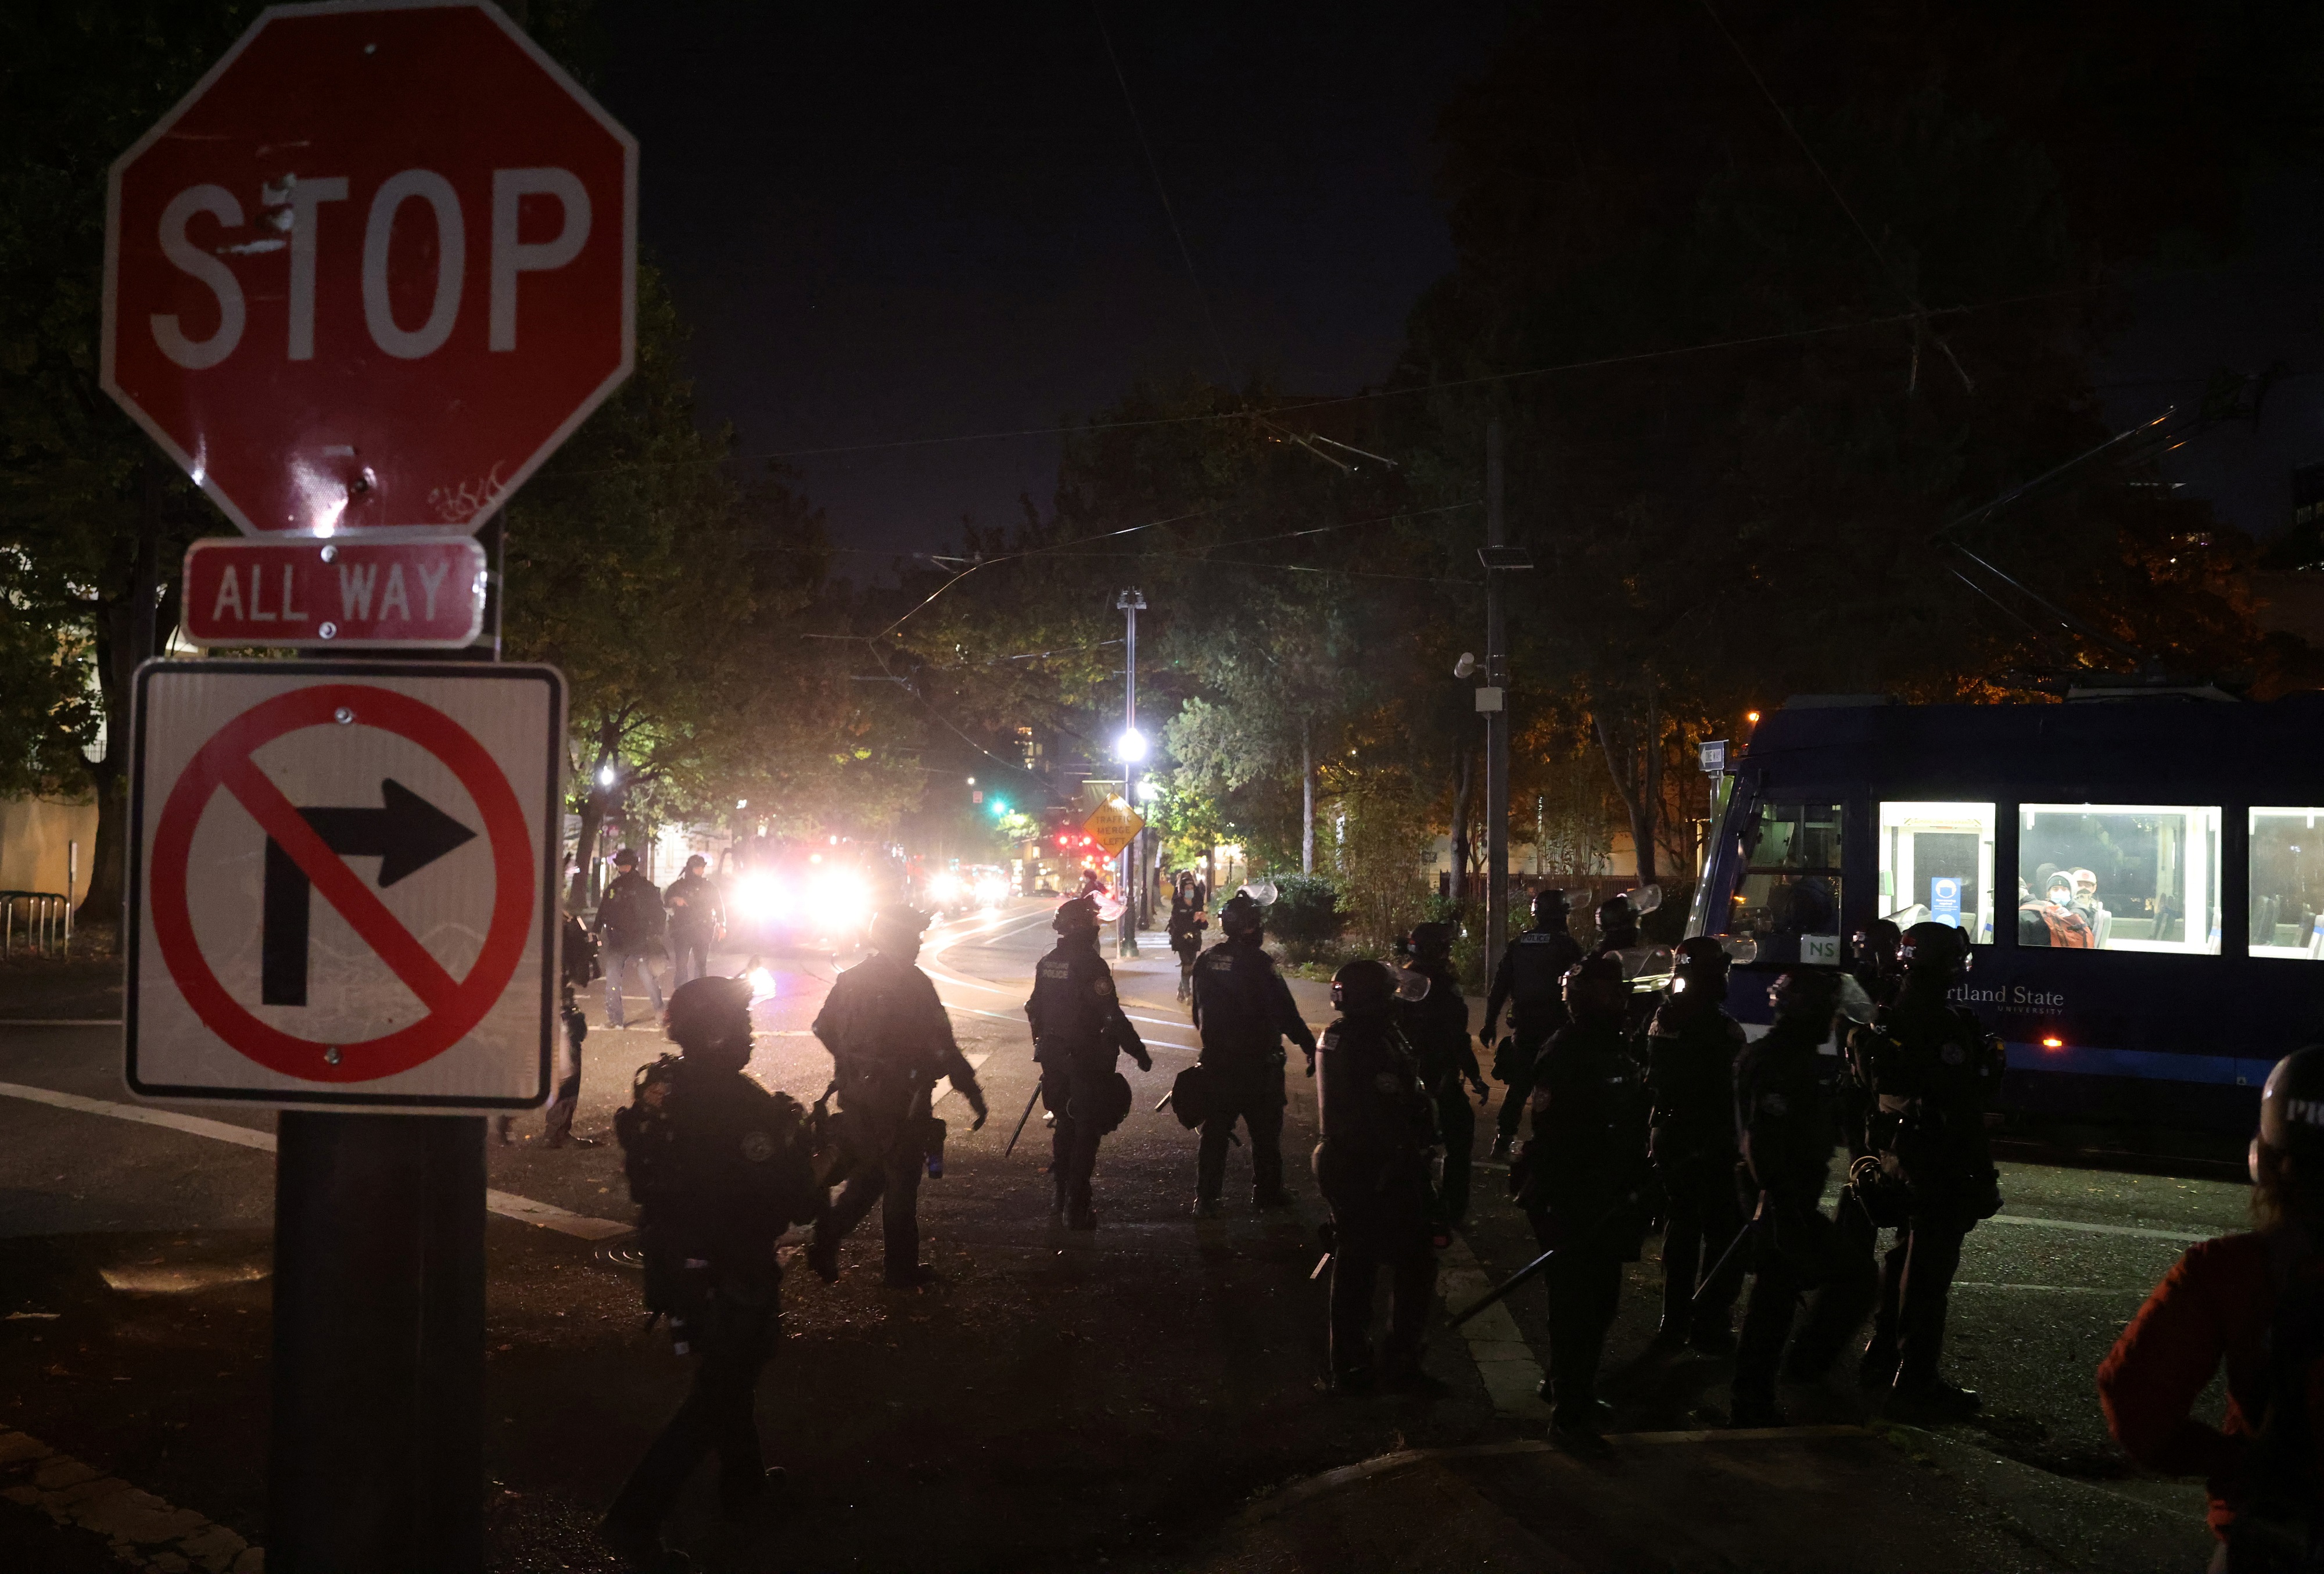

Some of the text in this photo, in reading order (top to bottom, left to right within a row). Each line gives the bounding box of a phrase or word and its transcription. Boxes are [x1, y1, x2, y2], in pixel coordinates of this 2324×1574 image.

[149, 166, 593, 370] STOP
[212, 562, 449, 621] ALL WAY
[1103, 805, 1124, 813] THRU
[1096, 815, 1131, 824] TRAFFIC
[1098, 826, 1131, 834] MERGE
[1103, 837, 1125, 845] LEFT
[1522, 934, 1550, 942] POLICE
[1810, 942, 1835, 957] NS
[1946, 983, 2064, 1006] rtland State
[1997, 1005, 2063, 1016] UNIVERSITY
